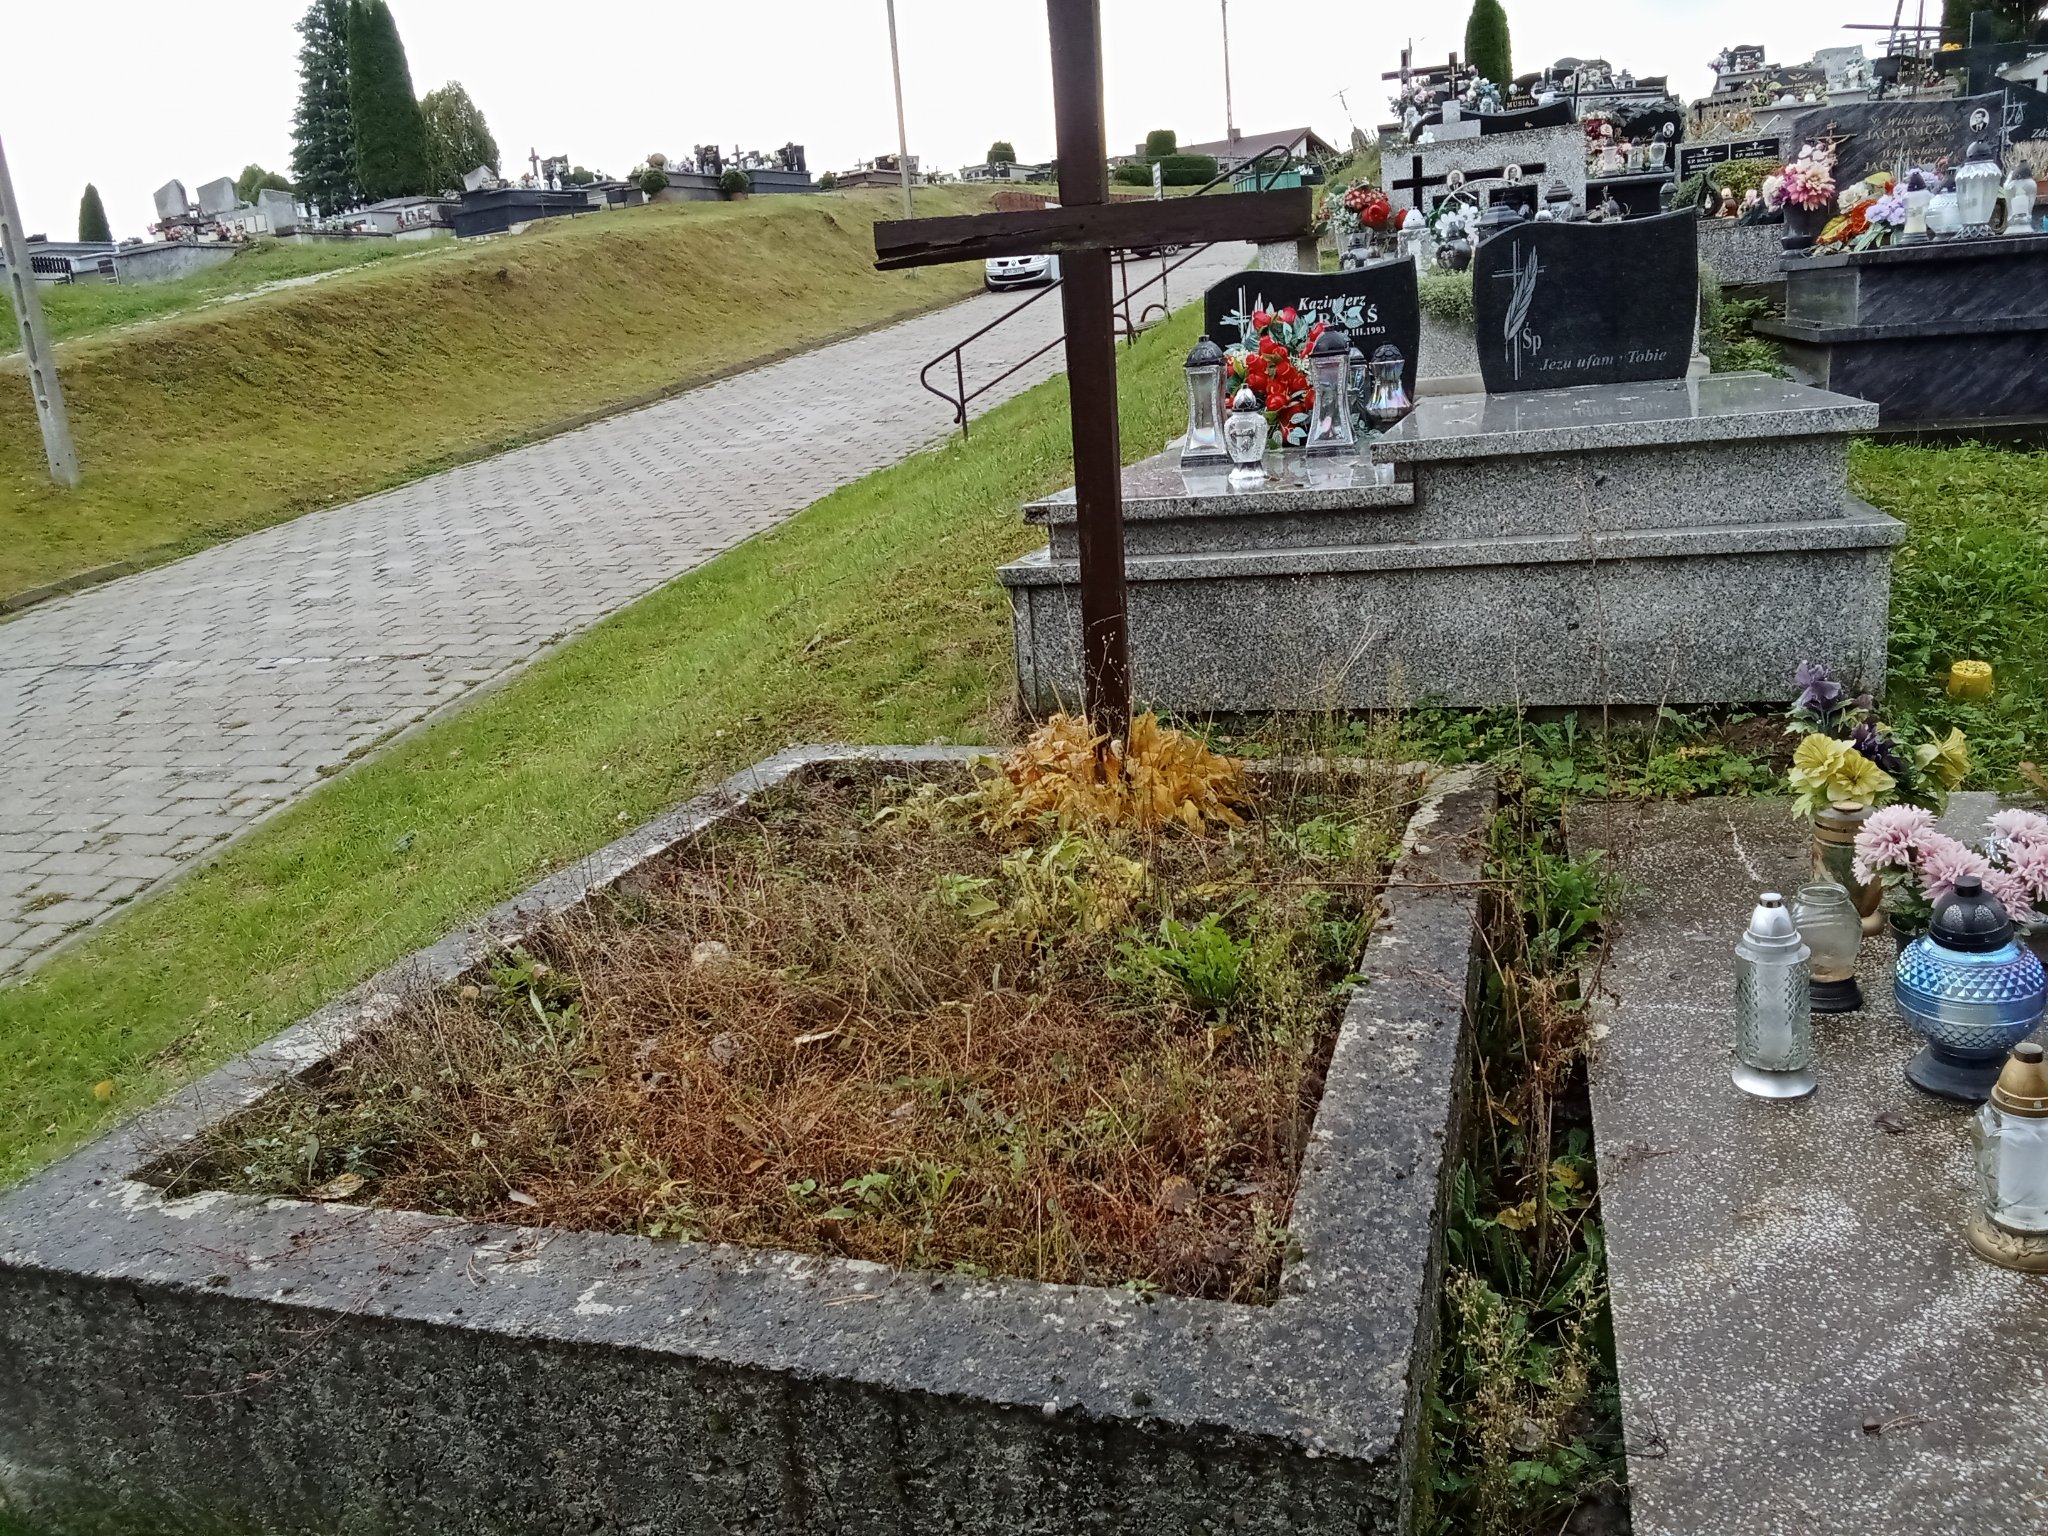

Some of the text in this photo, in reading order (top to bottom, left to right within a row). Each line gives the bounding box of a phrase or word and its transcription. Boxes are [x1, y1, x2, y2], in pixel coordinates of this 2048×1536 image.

[1539, 357, 1573, 371] Jezu
[1576, 353, 1614, 370] ufam
[1627, 348, 1668, 363] Tobie
